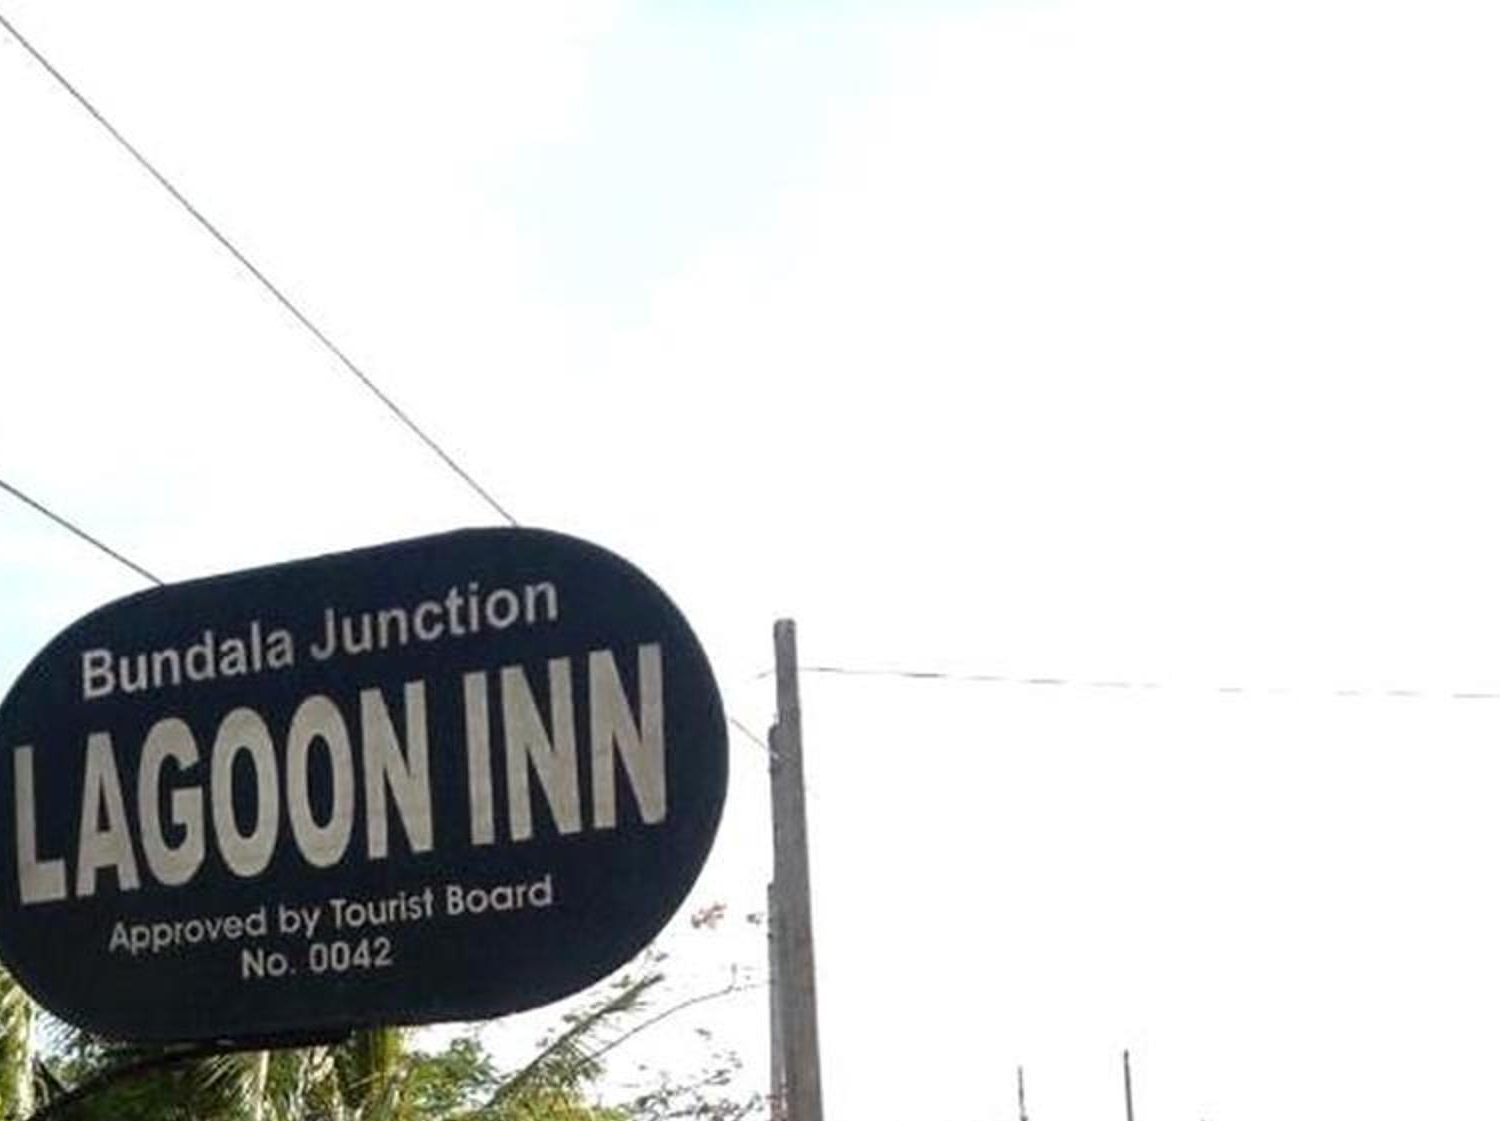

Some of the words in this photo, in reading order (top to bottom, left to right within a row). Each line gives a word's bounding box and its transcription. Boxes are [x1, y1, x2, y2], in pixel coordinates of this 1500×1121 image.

[82, 622, 294, 700] Bundala
[310, 581, 558, 660] Junction
[14, 680, 434, 905] LAGOON
[463, 643, 667, 846] INN
[109, 907, 267, 954] Approved
[278, 906, 321, 938] by
[329, 887, 434, 928] Tourist
[446, 874, 553, 916] Board
[241, 948, 297, 979] No.
[309, 936, 392, 973] 0042
